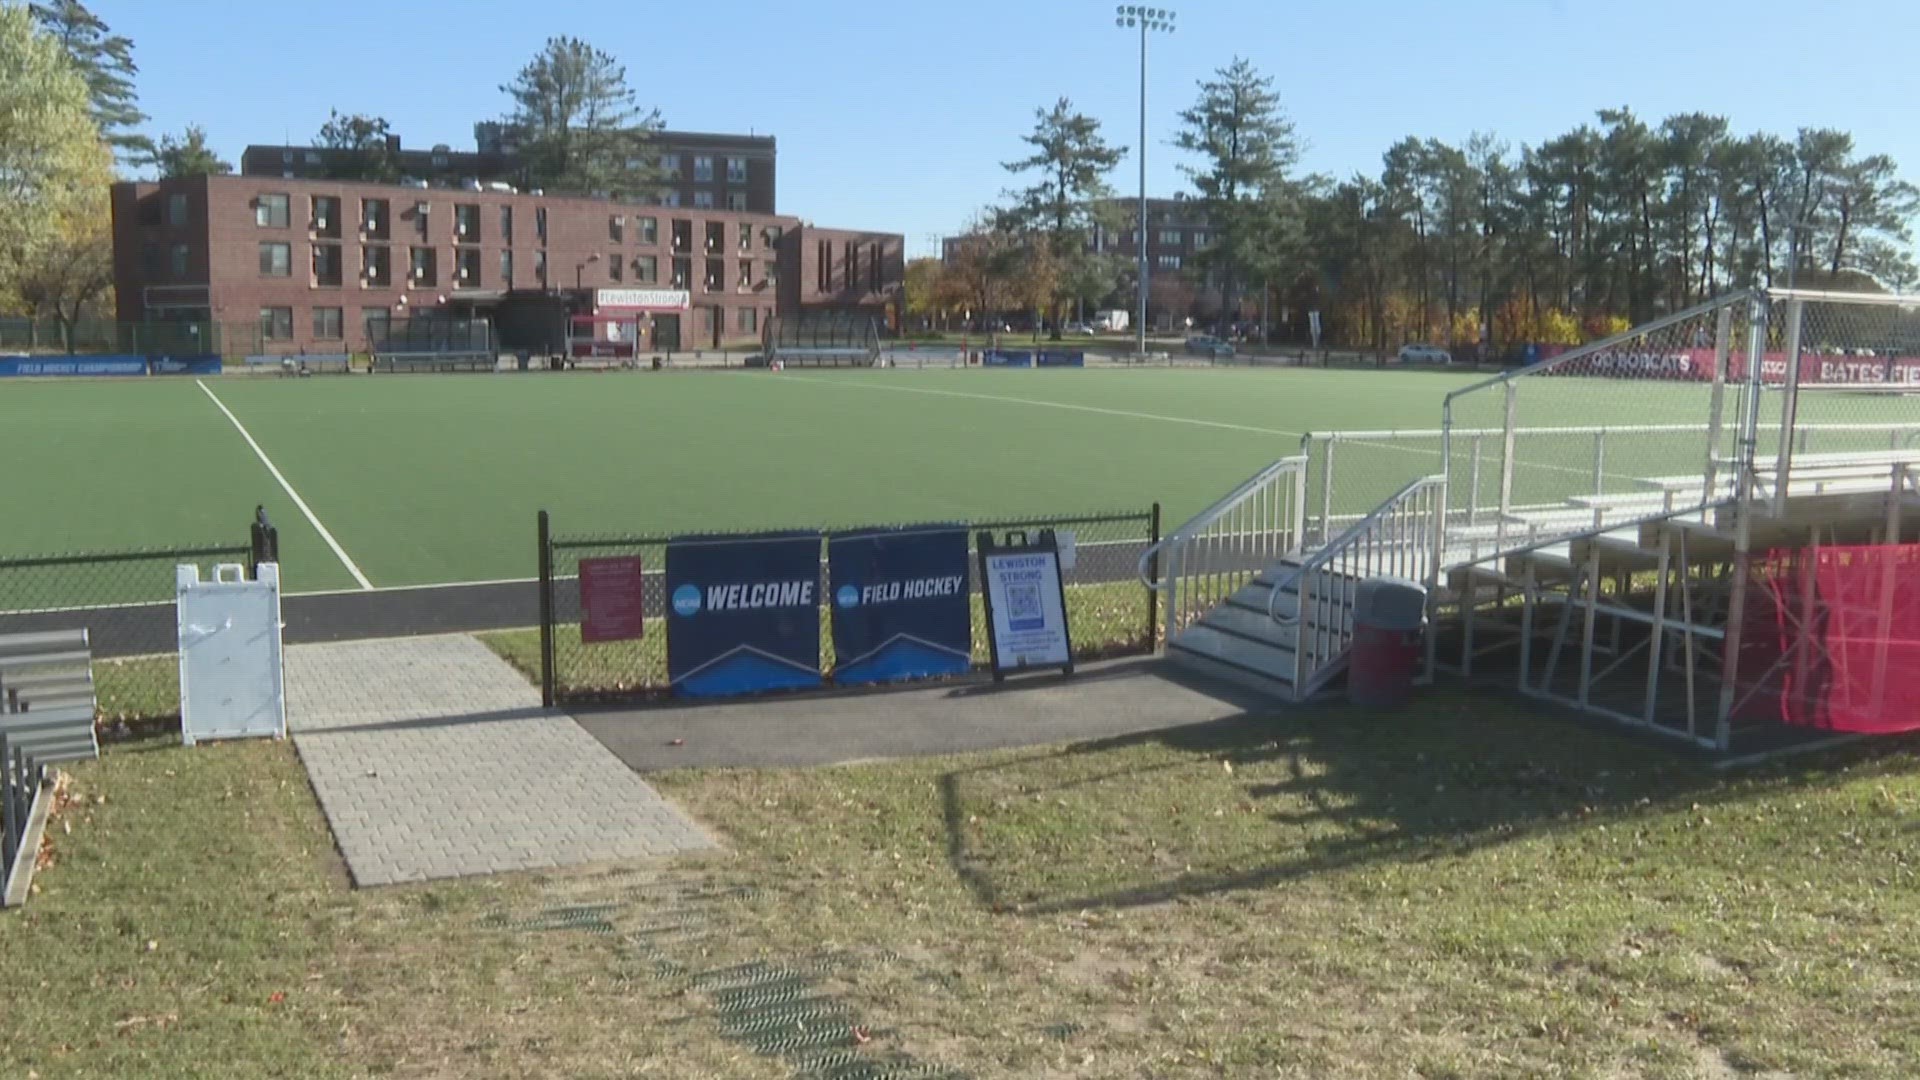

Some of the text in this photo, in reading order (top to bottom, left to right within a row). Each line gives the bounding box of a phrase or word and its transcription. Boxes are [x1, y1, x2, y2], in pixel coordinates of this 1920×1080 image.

[1618, 353, 1690, 371] BOBCATS
[1821, 361, 1884, 382] BATES
[993, 556, 1046, 569] LEWISTON
[1000, 571, 1042, 582] STRONG
[707, 581, 813, 611] WELCOME
[862, 575, 963, 605] FIELD HOCKEY
